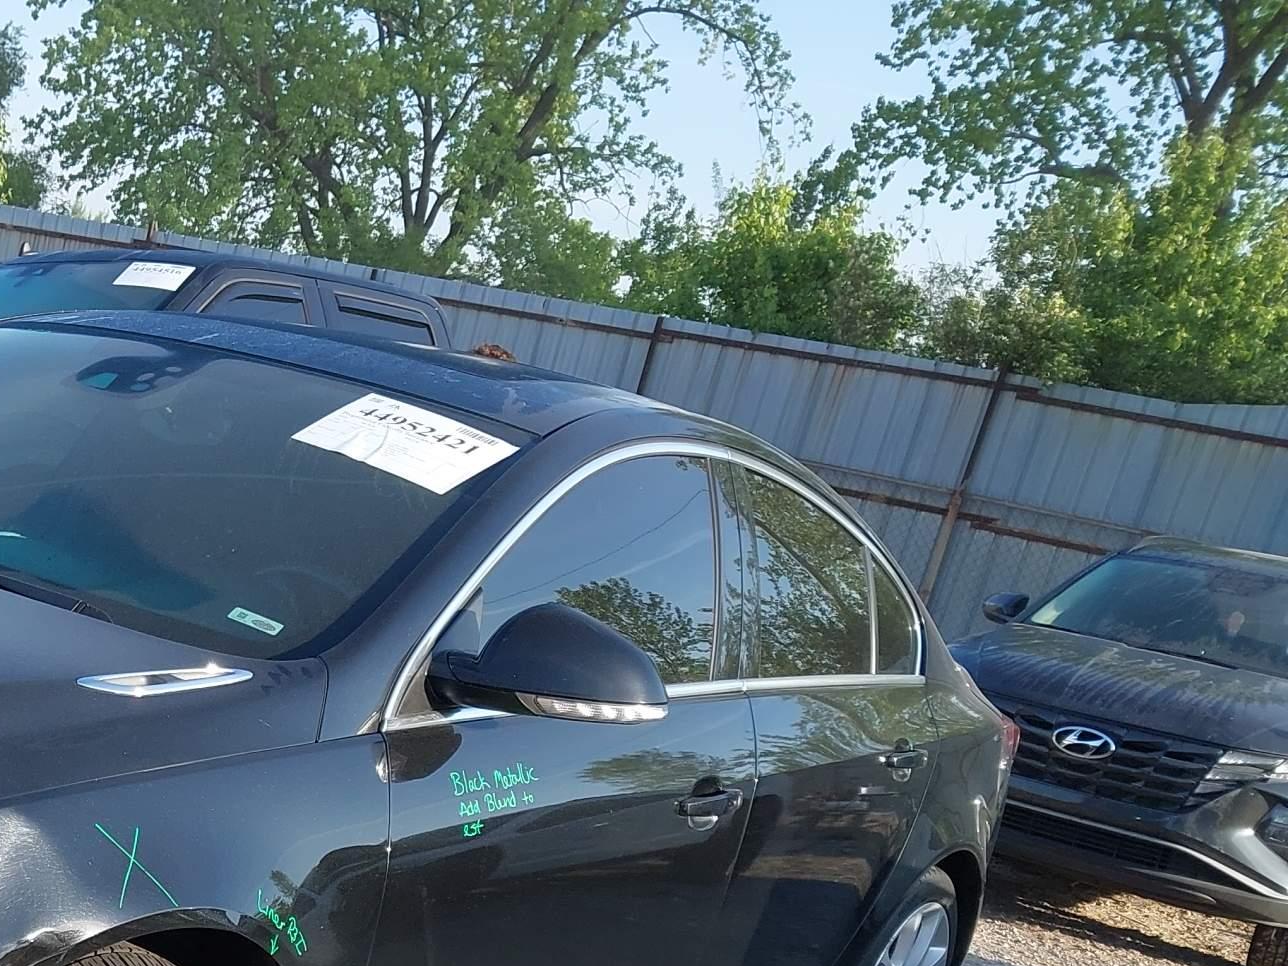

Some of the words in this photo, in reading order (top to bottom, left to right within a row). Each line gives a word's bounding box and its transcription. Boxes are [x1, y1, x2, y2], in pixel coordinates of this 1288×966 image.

[359, 408, 480, 455] 44952421
[450, 769, 491, 796] Black
[494, 762, 540, 789] Metallic
[459, 799, 481, 817] Add
[522, 791, 534, 804] to
